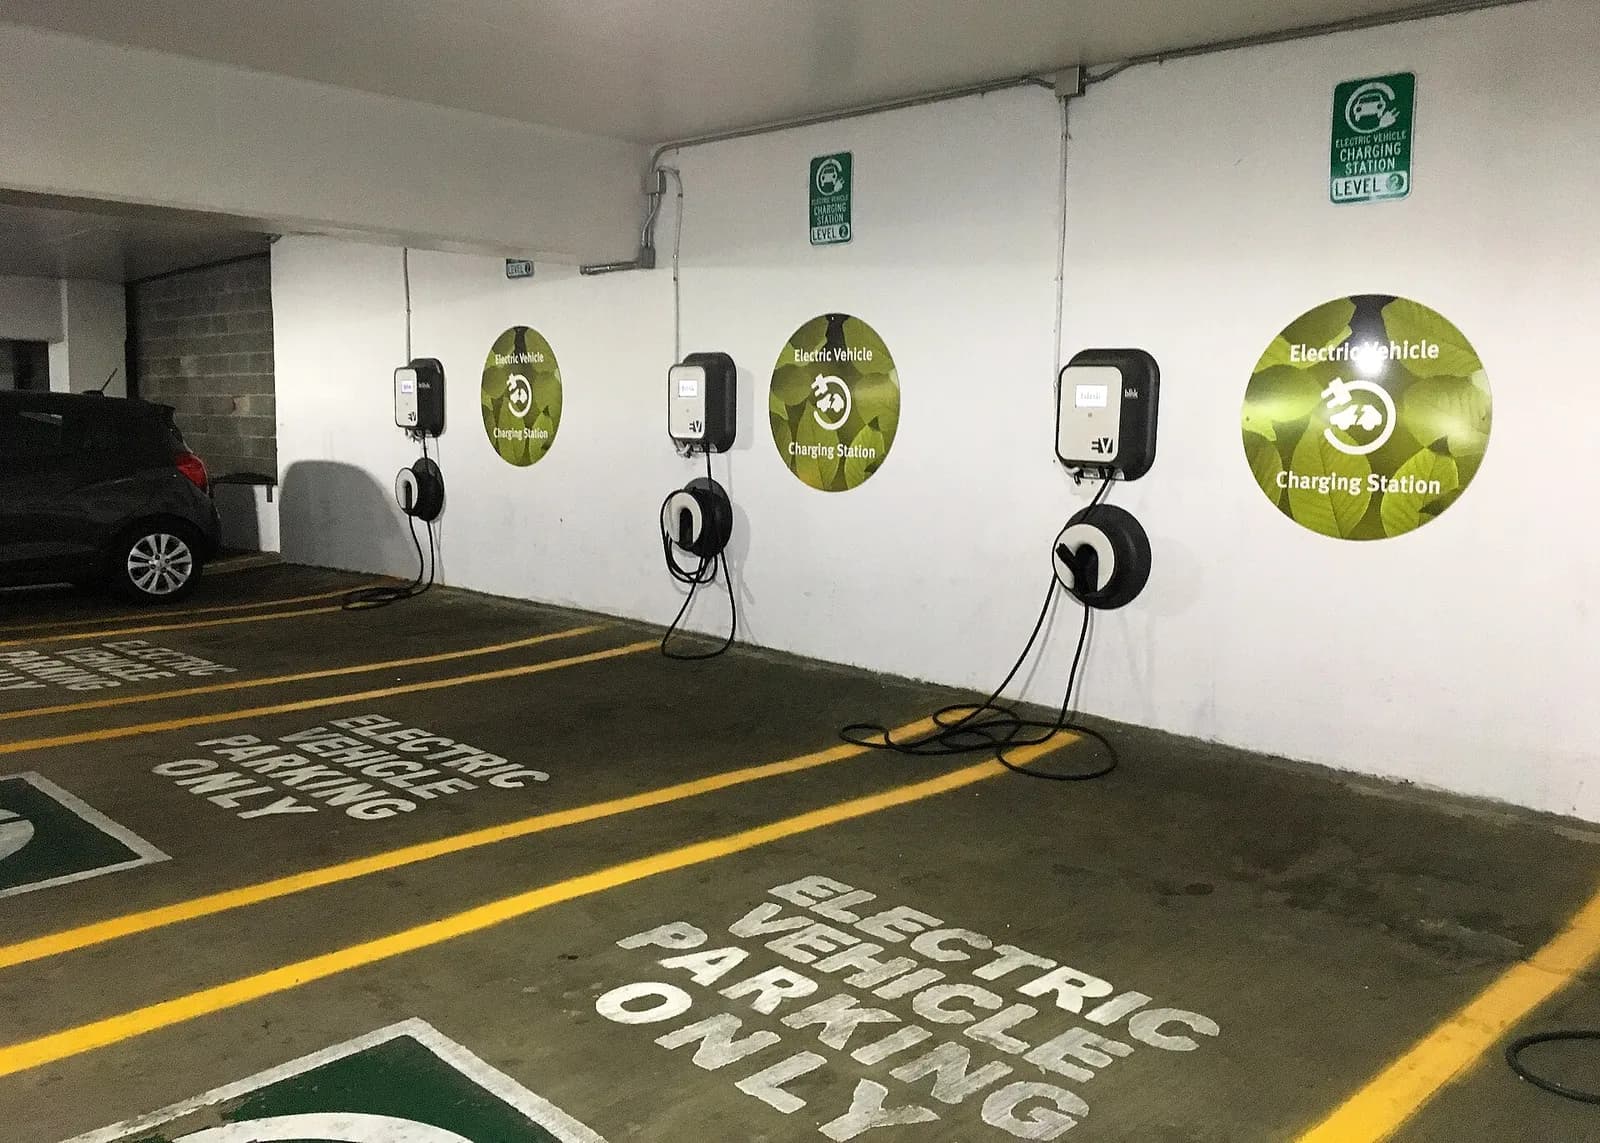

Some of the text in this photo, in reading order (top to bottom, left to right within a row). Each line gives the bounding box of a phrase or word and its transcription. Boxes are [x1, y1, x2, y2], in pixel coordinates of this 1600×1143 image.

[1336, 130, 1407, 148] ELECTRIC VEHICLE
[1340, 142, 1401, 161] CHARGING
[1345, 157, 1395, 175] STATION
[1335, 177, 1380, 196] LEVEL
[814, 203, 846, 215] CHARGING
[817, 214, 843, 226] STATION
[812, 227, 836, 240] LEVEL
[495, 352, 544, 365] Electric Vehicle
[794, 347, 873, 362] Electric Vehicle
[1290, 343, 1360, 362] Electric
[493, 428, 548, 440] Charging Station
[789, 442, 876, 460] Charging Station
[1276, 471, 1441, 495] Charging Station
[329, 714, 550, 789] ELECTRIC
[278, 727, 479, 800] VEHICLE
[195, 734, 417, 820] PARKING
[152, 758, 319, 820] ONLY
[768, 875, 1220, 1052] ELECTRIC
[728, 902, 1134, 1082] VEHICLE
[616, 921, 1090, 1142] PARKING
[595, 981, 941, 1143] ONLY
